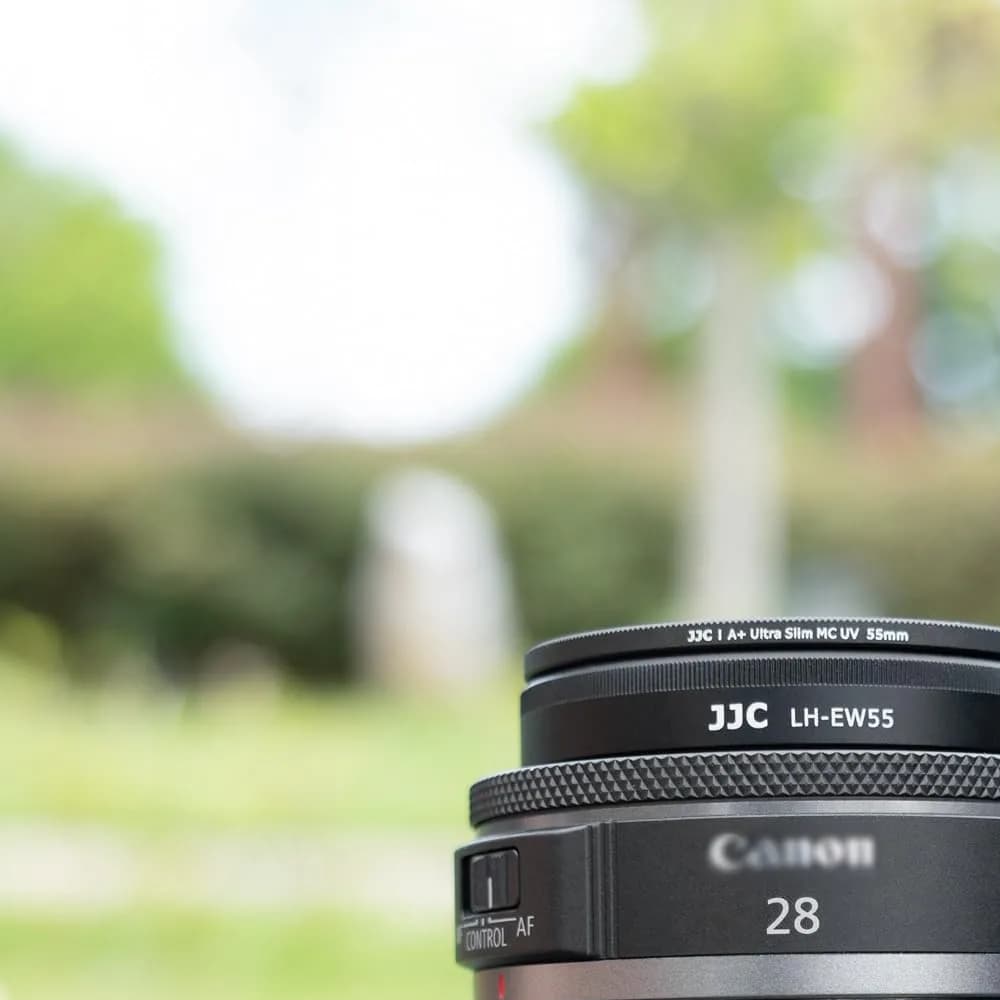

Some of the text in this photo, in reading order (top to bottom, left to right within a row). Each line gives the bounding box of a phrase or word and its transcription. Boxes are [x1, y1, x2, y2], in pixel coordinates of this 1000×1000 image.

[688, 629, 712, 642] JJC
[727, 628, 746, 641] A+
[750, 627, 782, 640] Ultra
[784, 627, 813, 640] Slim
[816, 627, 838, 640] MC
[840, 627, 860, 640] UV
[866, 628, 909, 642] 55mm
[708, 702, 895, 731] JJC LH-EW55
[707, 833, 877, 872] Canon
[516, 915, 535, 937] AF
[766, 896, 820, 935] 28
[465, 927, 507, 952] CONTROL
